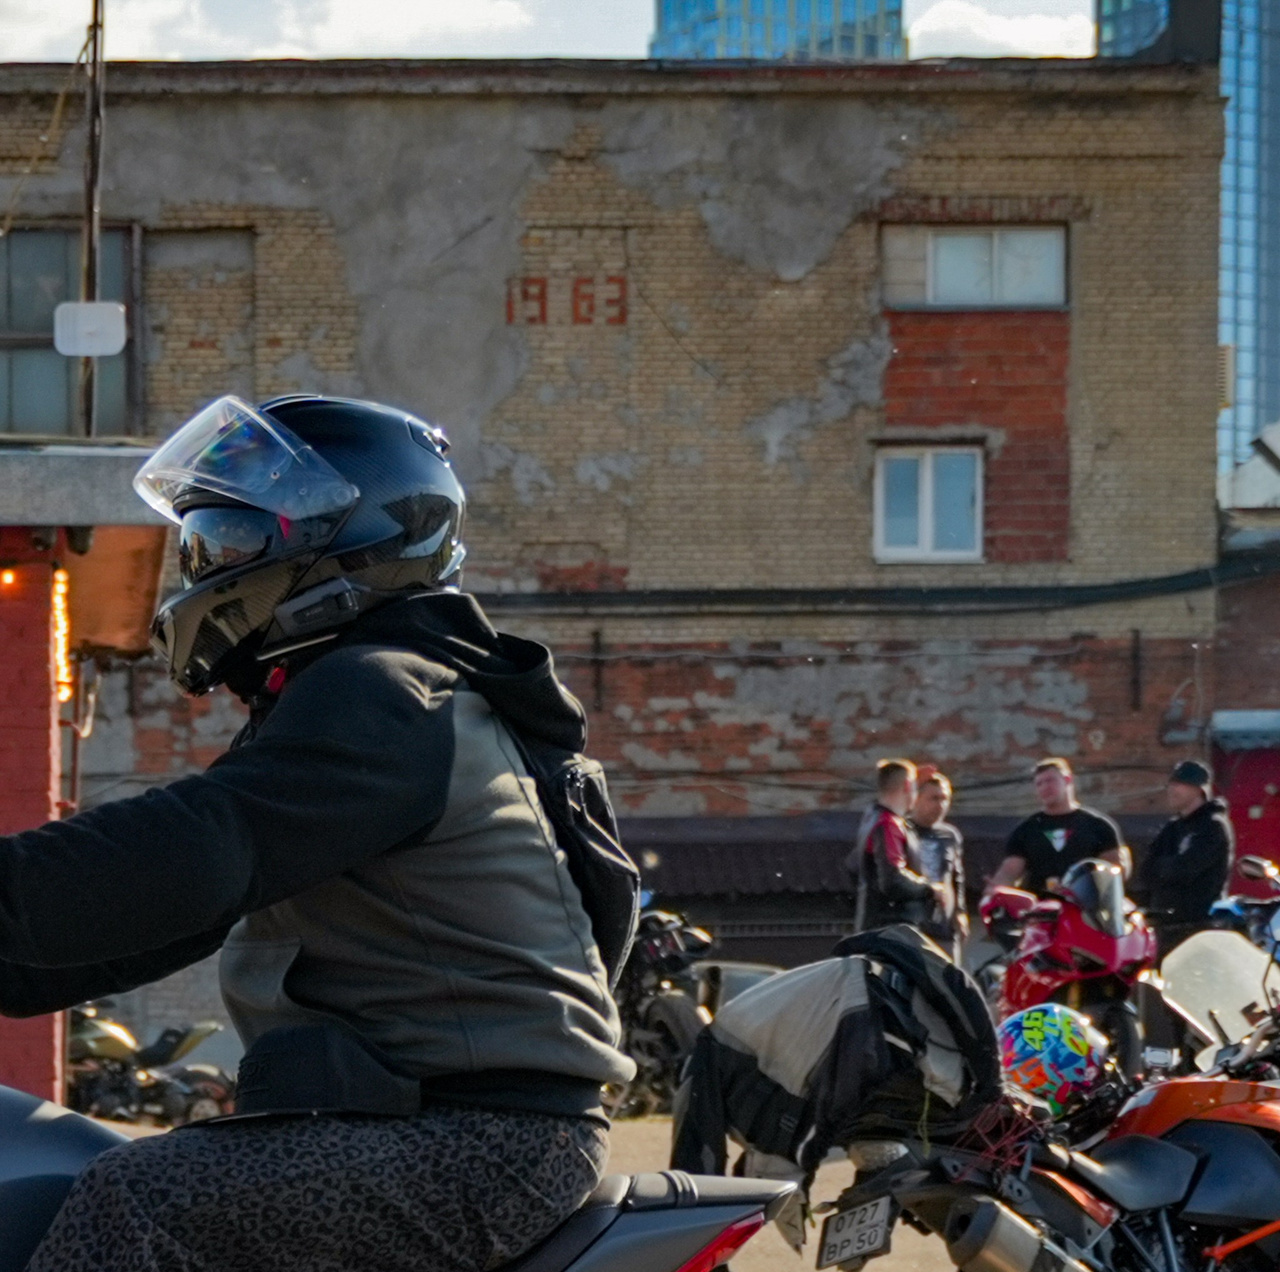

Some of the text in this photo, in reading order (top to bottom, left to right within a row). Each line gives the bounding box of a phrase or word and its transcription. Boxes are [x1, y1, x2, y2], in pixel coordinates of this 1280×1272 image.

[1022, 1011, 1045, 1051] 46
[834, 1201, 880, 1234] 0727
[856, 1229, 878, 1250] 50
